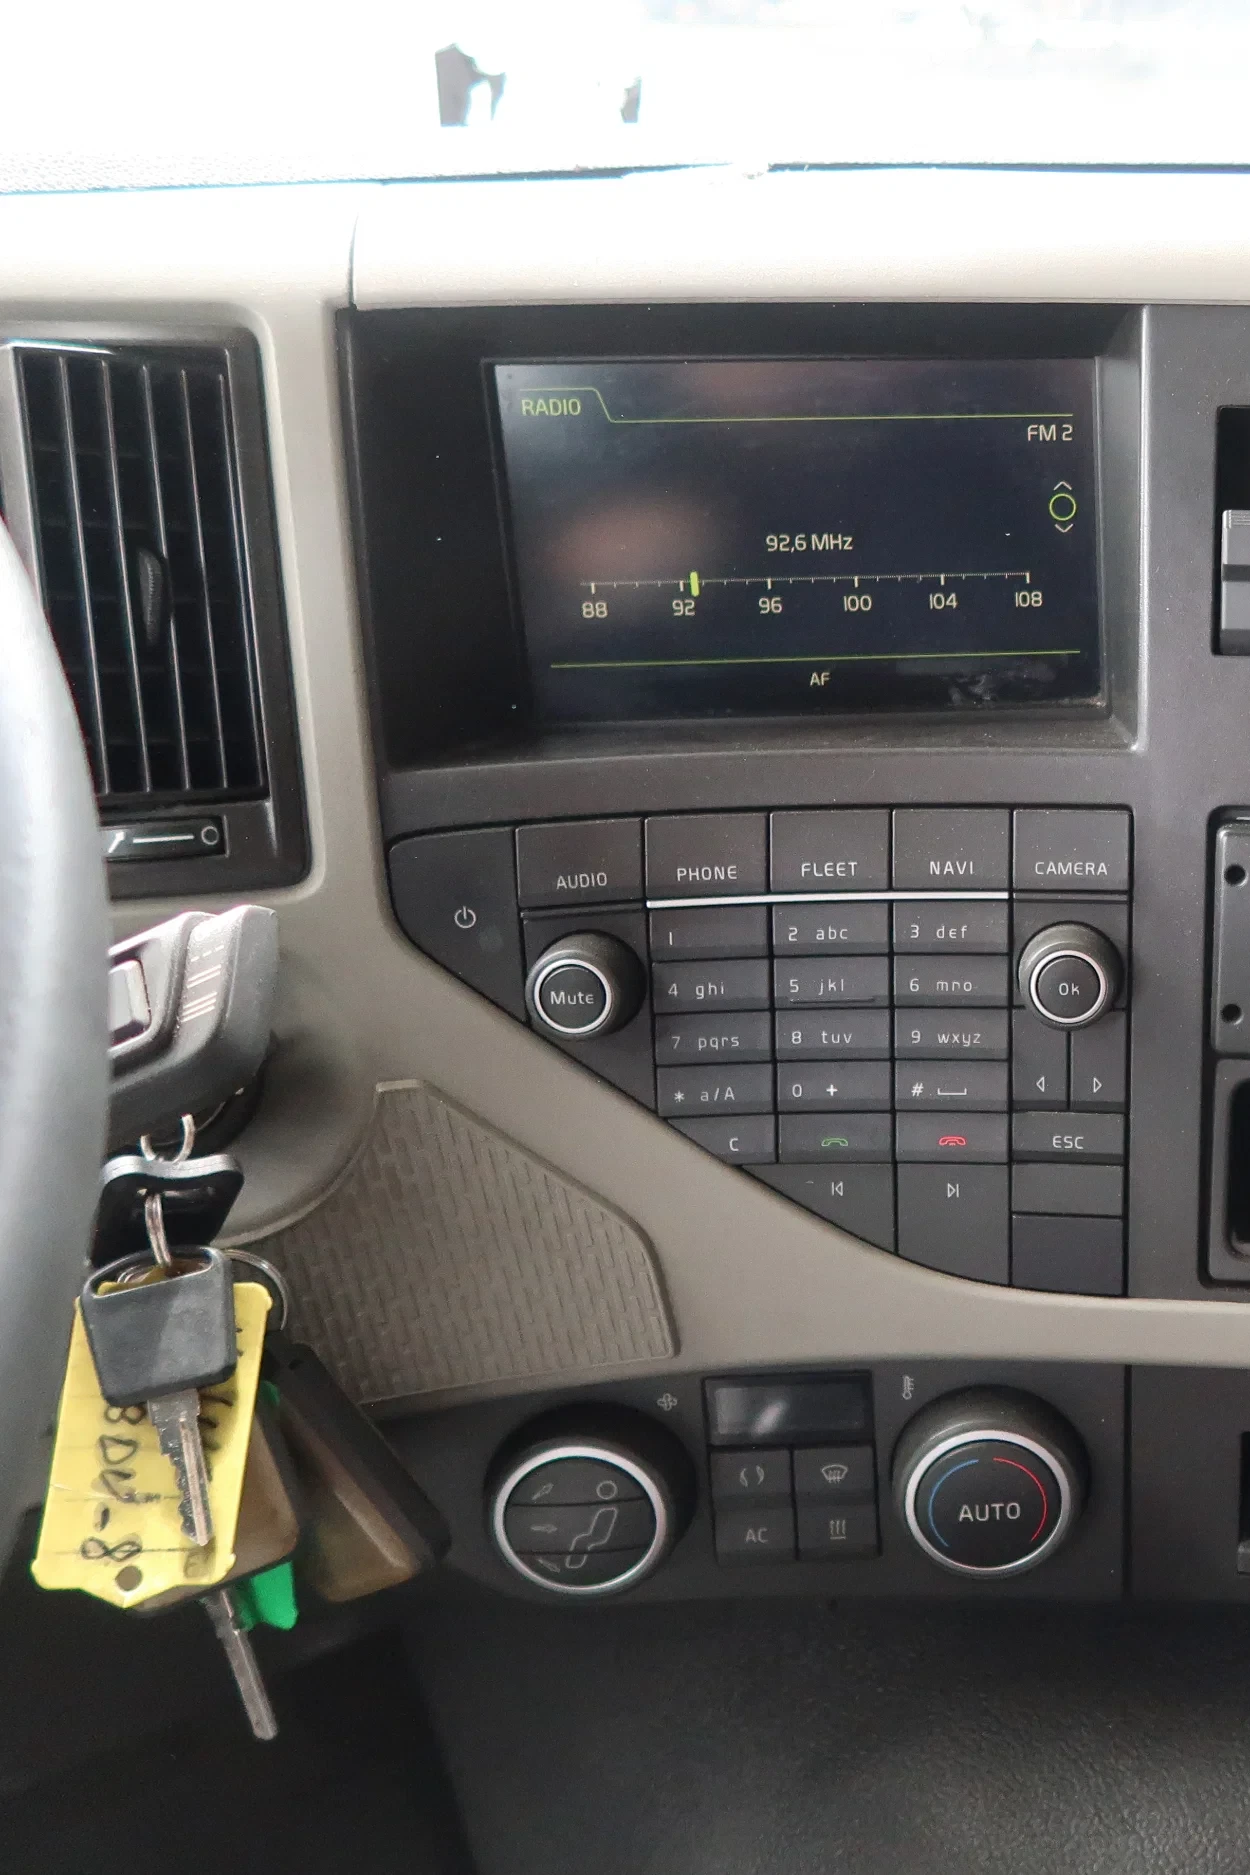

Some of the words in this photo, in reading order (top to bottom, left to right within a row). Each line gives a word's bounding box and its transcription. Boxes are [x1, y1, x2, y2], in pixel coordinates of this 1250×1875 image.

[521, 398, 581, 416] RADIO
[1026, 423, 1055, 442] FM
[1061, 423, 1074, 442] 2
[811, 533, 853, 551] MHz
[581, 601, 608, 619] 88
[671, 598, 696, 617] 92
[758, 597, 783, 614] 96
[843, 595, 872, 612] 100
[929, 592, 958, 610] 104
[1015, 591, 1043, 607] 108
[809, 672, 830, 686] AF
[676, 865, 738, 882] PHONE
[801, 861, 858, 878] FLEET
[929, 860, 973, 875] NAVI
[1035, 861, 1108, 876] CAMERA
[556, 871, 608, 890] AUDIO
[788, 927, 798, 942] 2
[815, 926, 848, 941] abc
[910, 924, 920, 939] 3
[936, 925, 968, 939] def
[668, 983, 678, 997] 4
[695, 982, 725, 1000] ghi
[789, 978, 799, 993] 5
[818, 978, 844, 996] jkl
[909, 977, 920, 992] 6
[936, 980, 973, 992] mno
[550, 990, 594, 1005] Mute
[671, 1035, 681, 1049] 7
[698, 1035, 740, 1052] pqrs
[791, 1030, 802, 1045] 8
[821, 1030, 853, 1044] tuv
[911, 1030, 921, 1044] 9
[937, 1033, 981, 1047] wxyz
[729, 1137, 739, 1152] C
[1052, 1135, 1084, 1150] ESC
[958, 1502, 1021, 1522] AUTO
[744, 1526, 769, 1545] AC
